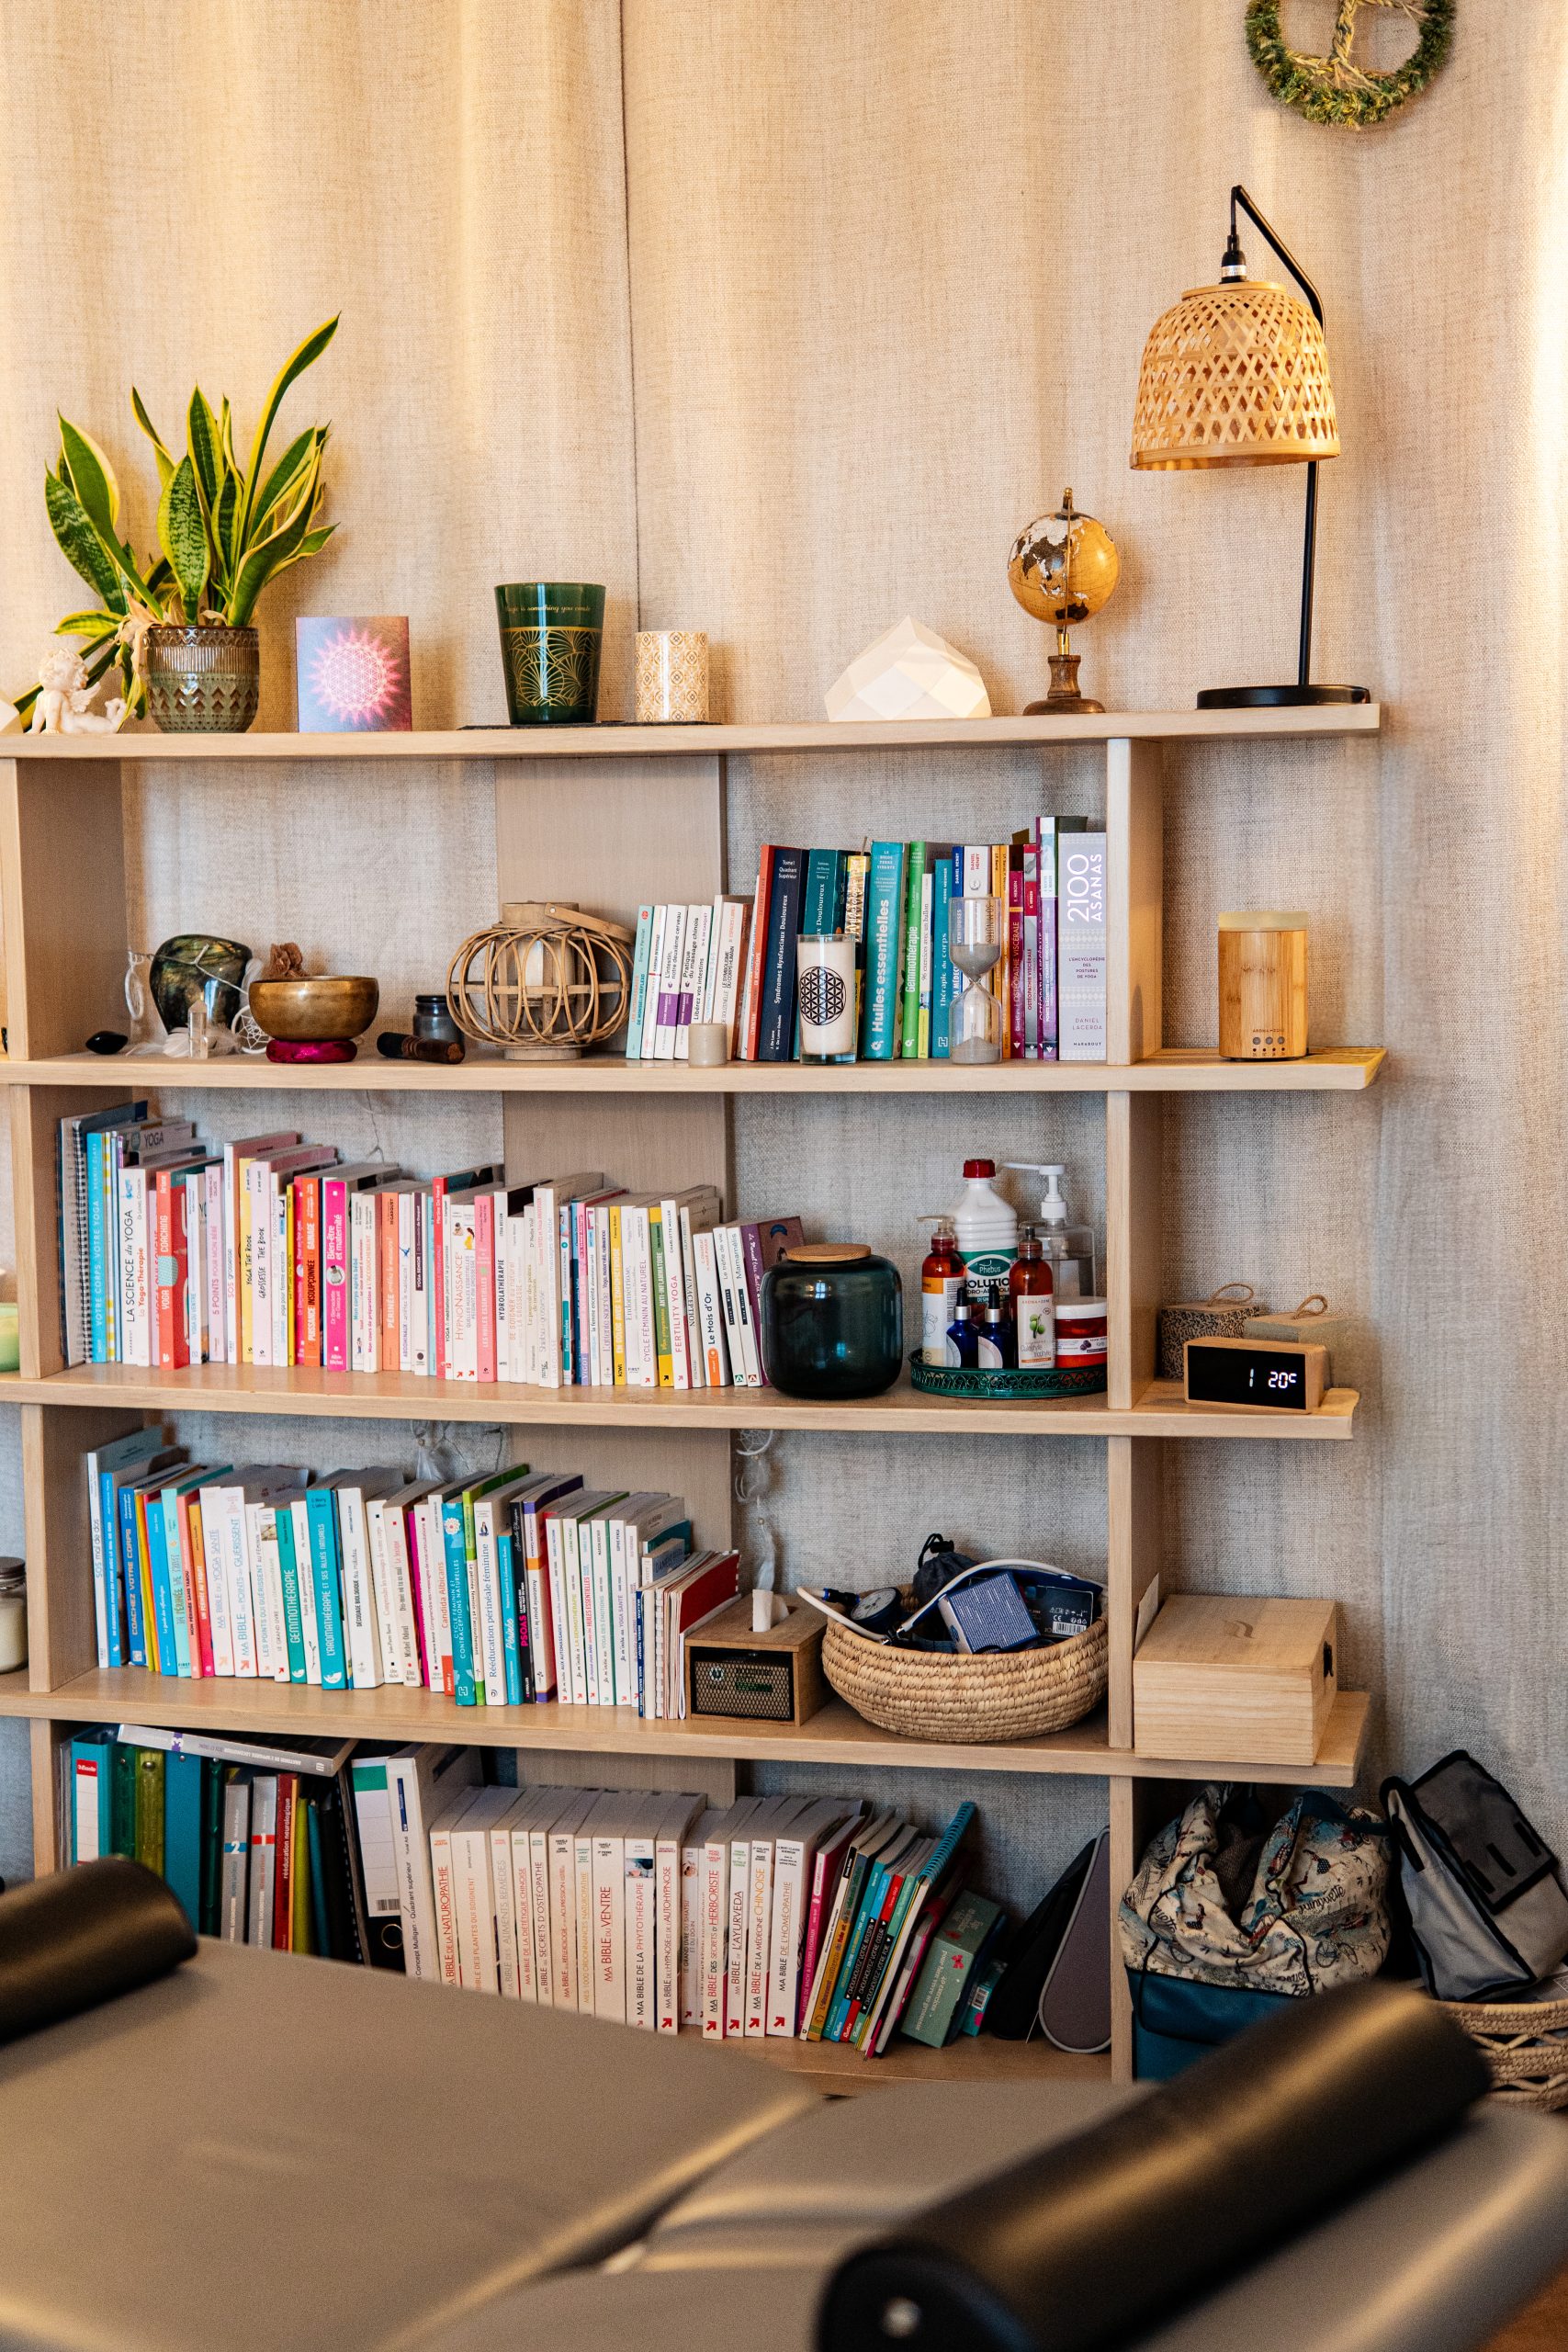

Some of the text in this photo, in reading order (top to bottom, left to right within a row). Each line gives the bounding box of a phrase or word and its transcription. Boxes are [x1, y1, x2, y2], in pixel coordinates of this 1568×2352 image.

[816, 884, 826, 926] Douloureux
[1066, 854, 1089, 922] 2100
[1089, 854, 1102, 922] ASANAS
[773, 895, 789, 1004] Syndromes Myofasciaux Douloureux
[873, 899, 890, 985] essentielles
[922, 922, 928, 931] un
[985, 914, 995, 943] MINUTES
[683, 950, 692, 978] Pratique
[689, 970, 694, 978] du
[690, 941, 698, 968] massage
[696, 958, 705, 984] intestins
[905, 926, 919, 993] Gemmothérapie
[940, 933, 948, 1007] Thérapie du corps
[1011, 922, 1021, 1002] OSTÉOPATHIE VISCÉRALE
[694, 997, 702, 1020] Libérez
[872, 985, 886, 1032] Huiles
[144, 1131, 164, 1147] YOGA
[327, 1225, 335, 1261] Bien-être
[333, 1215, 343, 1252] maternité
[731, 1233, 742, 1279] Mamamélis
[92, 1201, 103, 1327] VOTRE VOTRE YOGA
[124, 1210, 135, 1322] LA SCIENCE du YOGA
[137, 1248, 145, 1307] Yoga-Thérapie
[160, 1215, 170, 1309] YOGA COACHING
[227, 1248, 235, 1280] grossesse
[257, 1227, 266, 1299] GROSSESSE THE BOOK
[639, 1260, 648, 1294] NATUREL
[964, 1277, 1010, 1288] SOLUTIO
[979, 1265, 1001, 1273] Phebus
[210, 1278, 220, 1308] POINTS
[306, 1260, 317, 1341] PUISSANCE INSOUPÇONNÉE
[386, 1294, 395, 1329] PÉRINÉE
[497, 1259, 506, 1320] HYDROLATHÉRAPIE
[641, 1295, 649, 1305] AU
[670, 1275, 682, 1352] FERTILITY YOGA
[685, 1274, 695, 1328] LUNACEPTION
[642, 1306, 650, 1340] FÉMININ
[704, 1293, 716, 1345] Le Mois d'Or
[92, 1519, 103, 1578] SOS mal de dos
[209, 1528, 221, 1581] YOGA SANTÉ
[125, 1528, 139, 1635] COACHEZ VOTRE CORPS
[321, 1570, 329, 1580] SES
[435, 1561, 448, 1629] Candida Albicans
[236, 1613, 248, 1641] BIBLE
[284, 1568, 301, 1644] GEMMOTHÉRAPIE
[321, 1590, 336, 1657] L'AROMATHÉRAPIE
[353, 1579, 363, 1627] DÉCODAGE BIOLOGIQUE
[480, 1544, 498, 1678] Rééducation périnéale féminine
[504, 1618, 515, 1651] Périnée
[518, 1614, 529, 1647] PSOAS
[230, 1840, 241, 1855] 2
[282, 1797, 291, 1879] rééducation neurologique
[405, 1861, 423, 1976] Concept Mulligan Quadrant supérieur
[437, 1866, 456, 1977] BIBLE DE LA NATUROPATHIE
[467, 1877, 480, 1970] DES PLANTES QUI SOIGNENT
[534, 1861, 548, 1986] BIBLE SECRETS D'OSTÉOPATHE
[600, 1886, 614, 1982] MA BIBLE VENTRE
[730, 1891, 743, 1984] BIBLE L'AYURVEDA
[750, 1868, 765, 2010] MA BIBLE DE LA MÉDECINE CHINOISE
[778, 1882, 792, 1992] MA BIBLE DE L'HOMÉOPATHIE
[860, 1923, 874, 1943] INTESTIN
[634, 1883, 645, 2016] MA BIBLE DE LA PHYTOTHÉRAPIE
[707, 1932, 717, 2013] MA BIBLE DES SECRETS
[855, 1943, 866, 1959] VOTRE
[857, 1943, 877, 1995] CHOUCHOUTEZ VOTRE
[863, 1944, 890, 2006] CHOUCHOUTEZ VOTRE FOIE
[560, 1970, 570, 1987] BIBLE
[663, 1979, 671, 2009] MA BIBLE
[847, 1960, 862, 1995] CHOUCHOUTEZ
[929, 1984, 944, 2012] exercices
